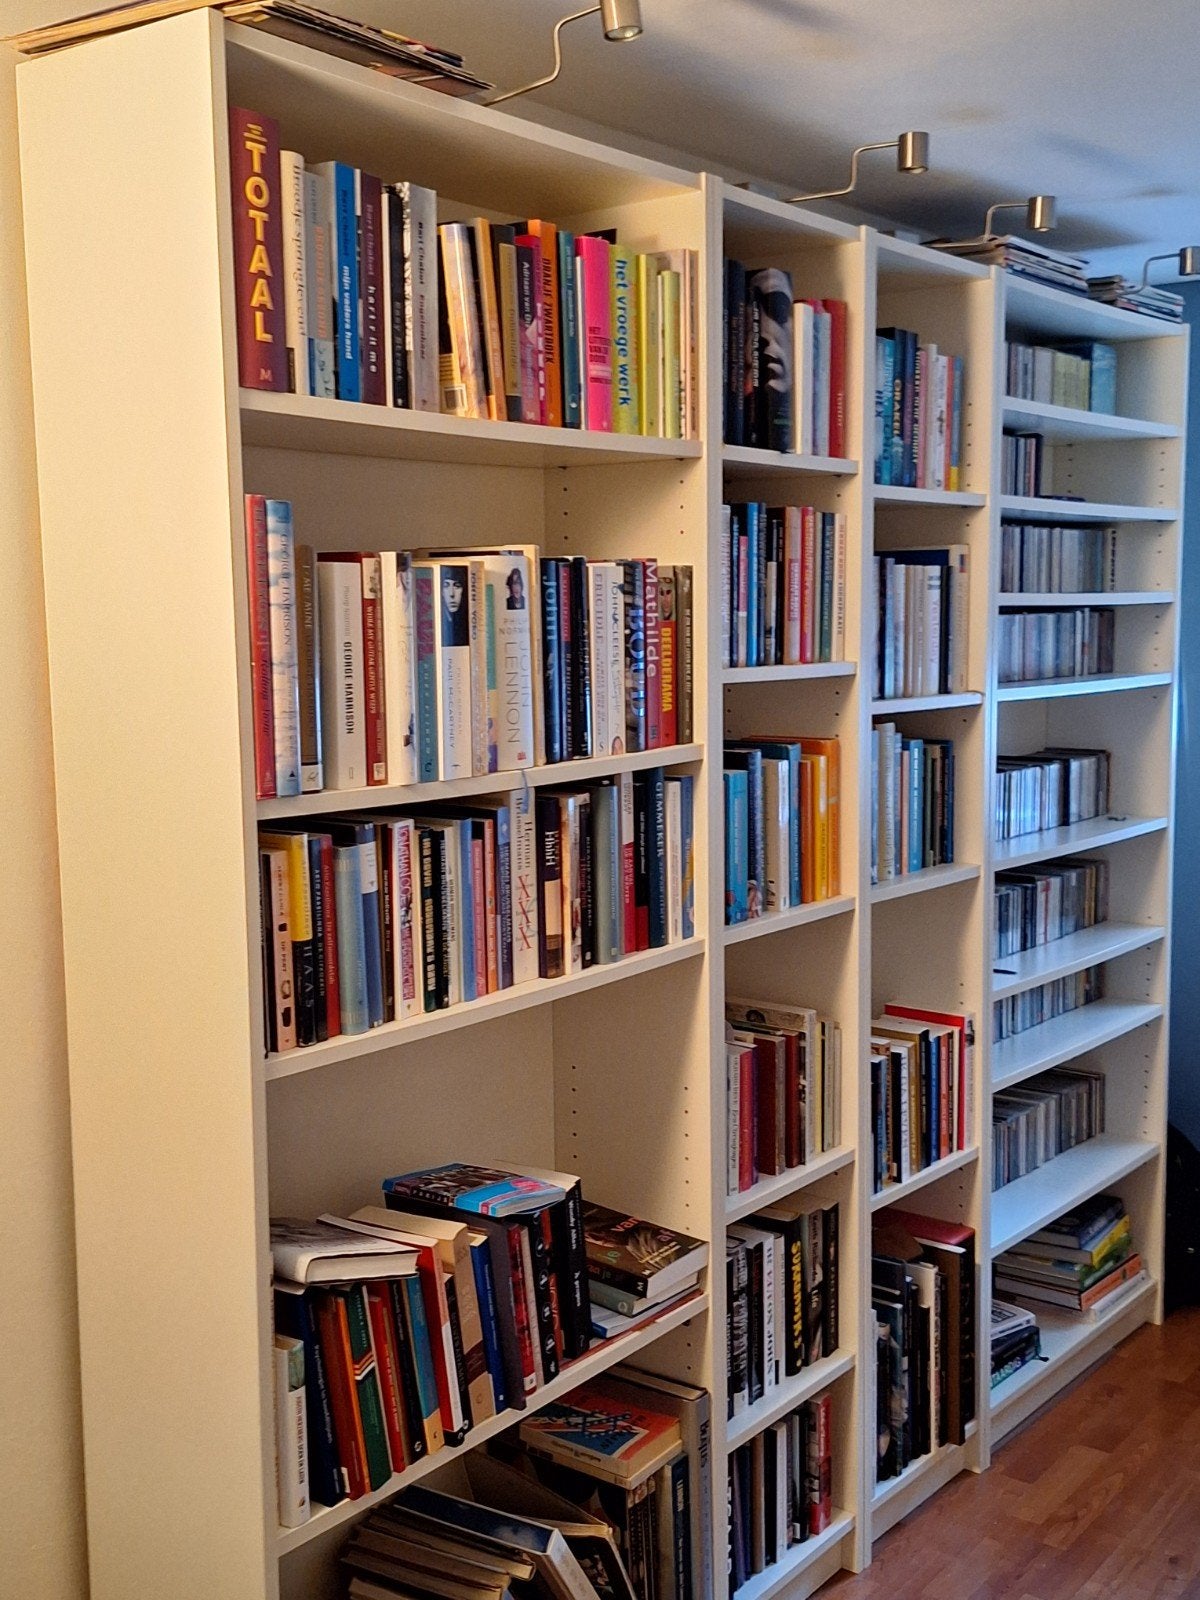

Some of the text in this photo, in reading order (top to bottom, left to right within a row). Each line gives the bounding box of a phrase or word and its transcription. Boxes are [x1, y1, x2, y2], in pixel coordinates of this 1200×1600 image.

[244, 141, 273, 342] TOTAAL
[342, 266, 353, 359] mijn vaders hand
[522, 262, 531, 296] Adriaan
[541, 258, 554, 364] ORANJE ZWARTBOEK
[395, 336, 403, 382] Street
[614, 260, 632, 406] het vroege werk
[283, 585, 293, 646] HARRISON
[594, 572, 605, 643] ERIC IDLE
[645, 561, 660, 678] Mathilde
[929, 599, 940, 665] Yesterday
[343, 641, 355, 735] GEORGE HARRISON
[504, 642, 521, 744] LENNON
[520, 640, 531, 708] JOHN
[660, 627, 673, 713] DEELDERAMA
[516, 797, 524, 871] Brusselmans
[525, 821, 533, 869] Herman
[544, 831, 556, 867] HhhH
[655, 782, 665, 858] GEMMEKER
[440, 839, 448, 874] HERMAN
[568, 1200, 577, 1228] Woody
[610, 1216, 641, 1232] van
[811, 1289, 820, 1308] Life
[313, 1344, 324, 1389] Psychologie
[766, 1329, 774, 1375] JOHN
